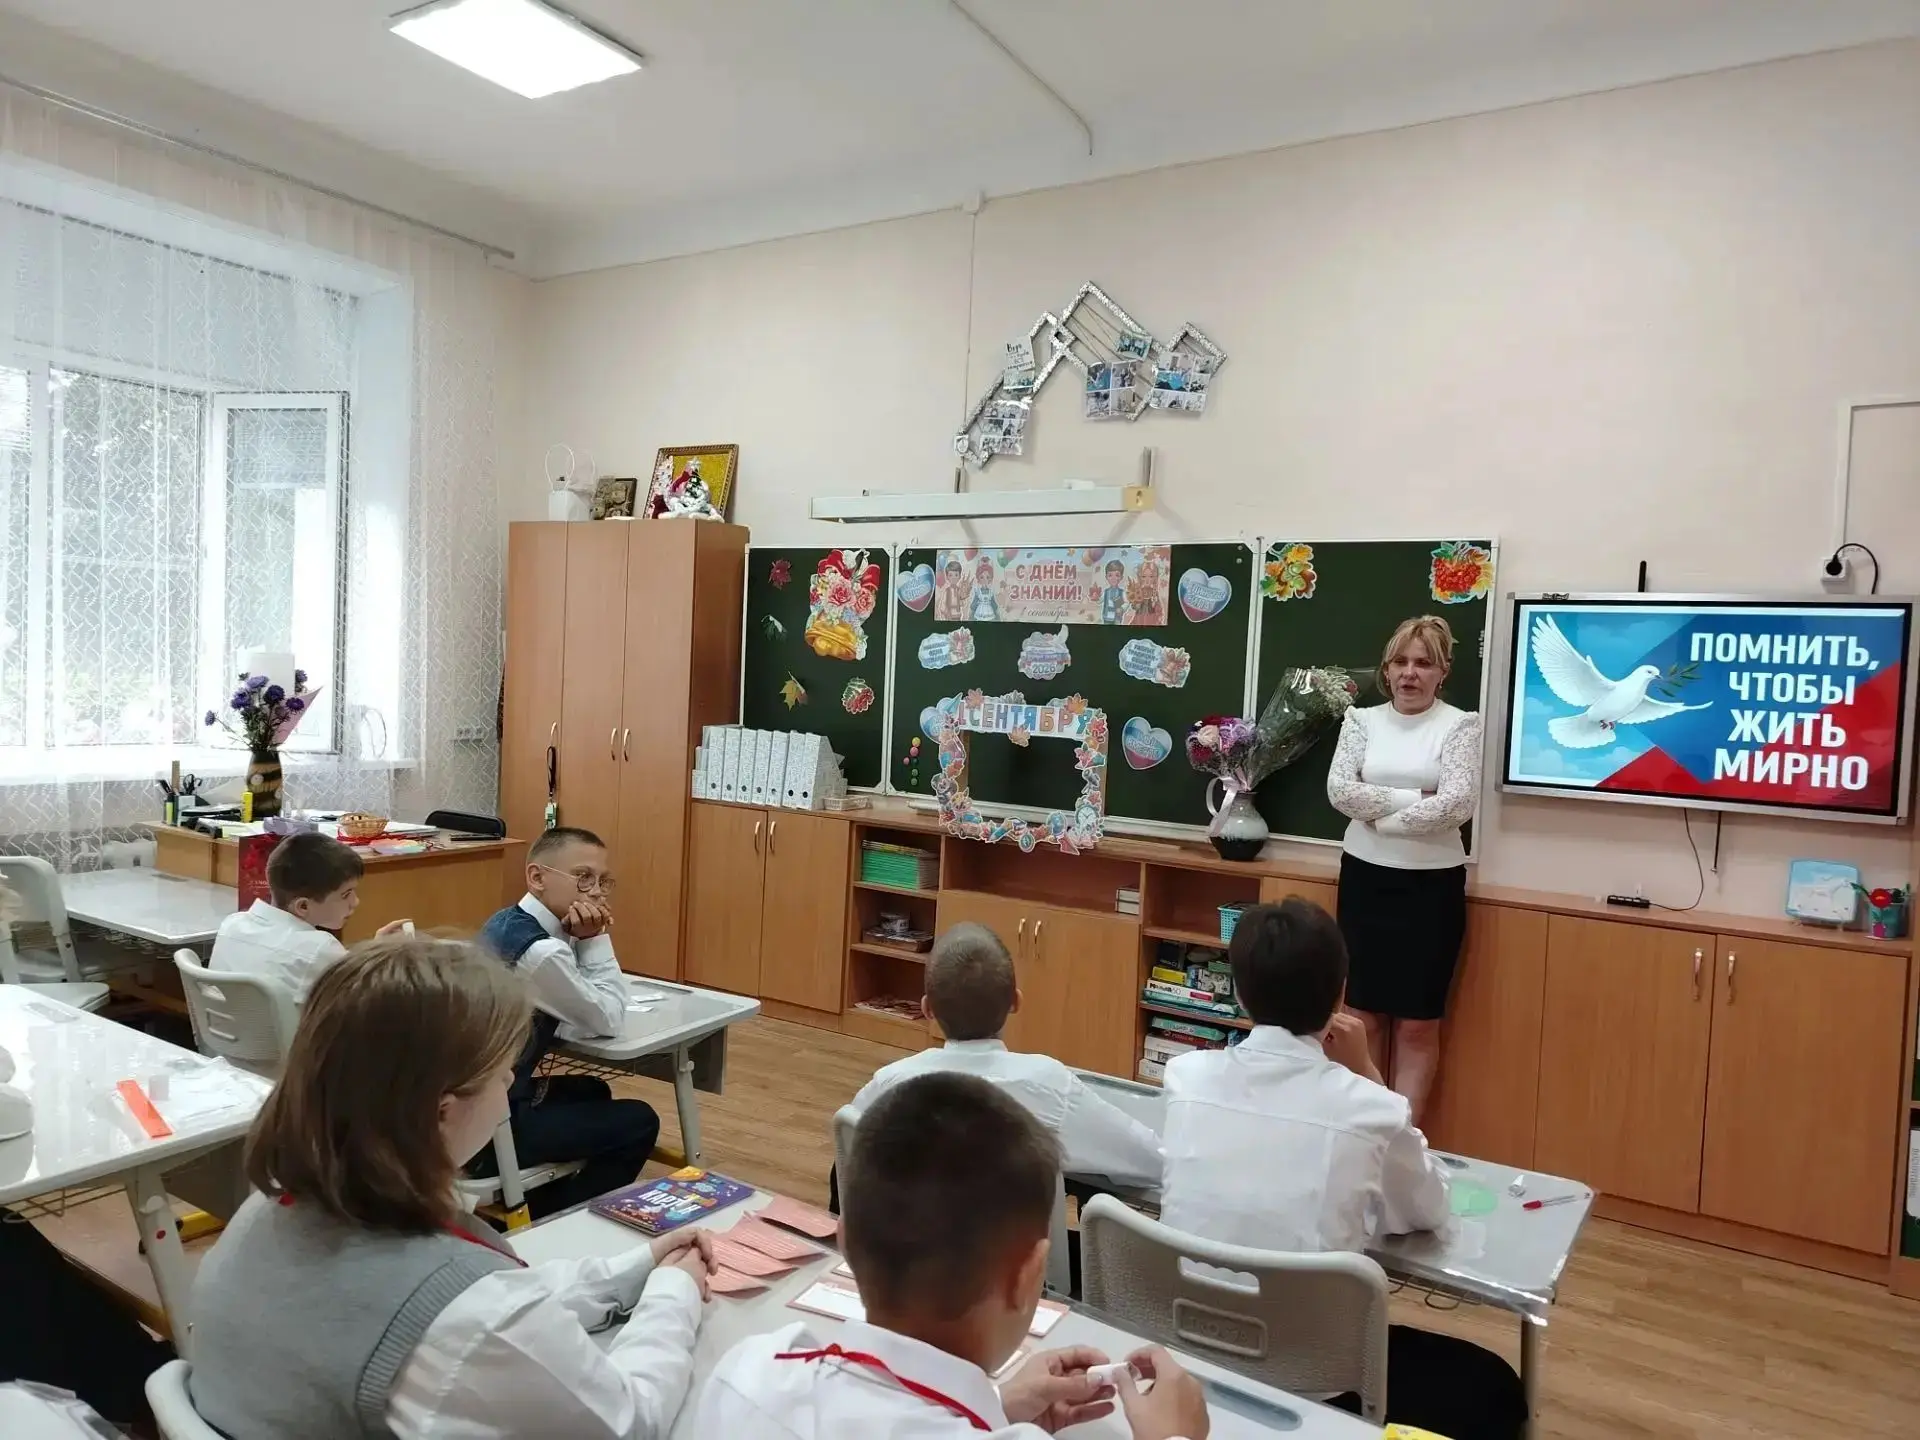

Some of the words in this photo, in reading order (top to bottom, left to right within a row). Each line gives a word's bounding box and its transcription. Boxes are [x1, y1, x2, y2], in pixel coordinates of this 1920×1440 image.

[1016, 565, 1025, 579] С
[1030, 561, 1077, 581] ДНЁМ
[1010, 582, 1082, 601] ЗНАНИЙ!
[1690, 632, 1880, 670] ПОМНИТЬ,
[1729, 671, 1856, 705] ЧТОБЫ
[1727, 709, 1847, 748] ЖИТЬ
[1714, 748, 1869, 790] МИРНО
[638, 1189, 702, 1215] КАРТН
